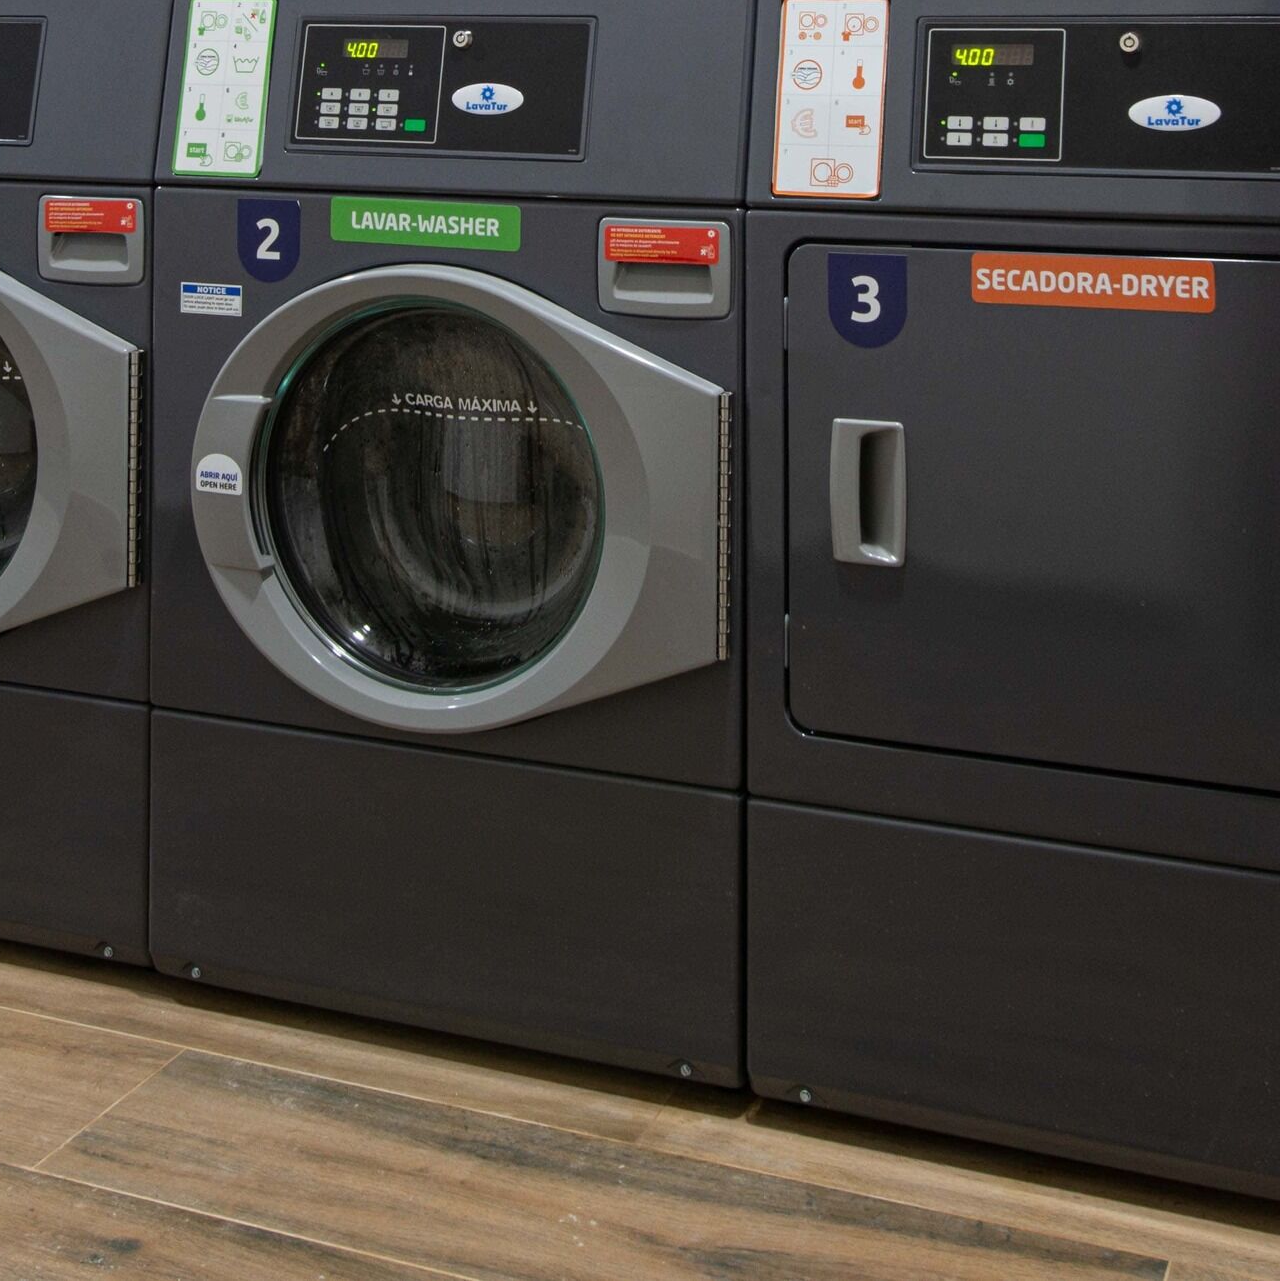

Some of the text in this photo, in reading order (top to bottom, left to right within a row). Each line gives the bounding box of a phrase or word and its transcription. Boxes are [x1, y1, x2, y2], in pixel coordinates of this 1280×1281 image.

[347, 42, 379, 58] 4.00
[955, 48, 995, 66] 4.00
[466, 101, 508, 112] LavaTur
[1147, 116, 1201, 127] LavaTur
[351, 210, 500, 238] LAVAR-WASHER
[255, 218, 281, 261] 2
[197, 286, 227, 295] NOTICE
[975, 267, 1210, 301] SECADORA-DRYER
[850, 275, 882, 323] 3
[404, 392, 522, 413] CARGA MÁXIMA
[200, 470, 238, 482] ABRIR AQUÍ
[200, 480, 237, 491] OPEN HERE
